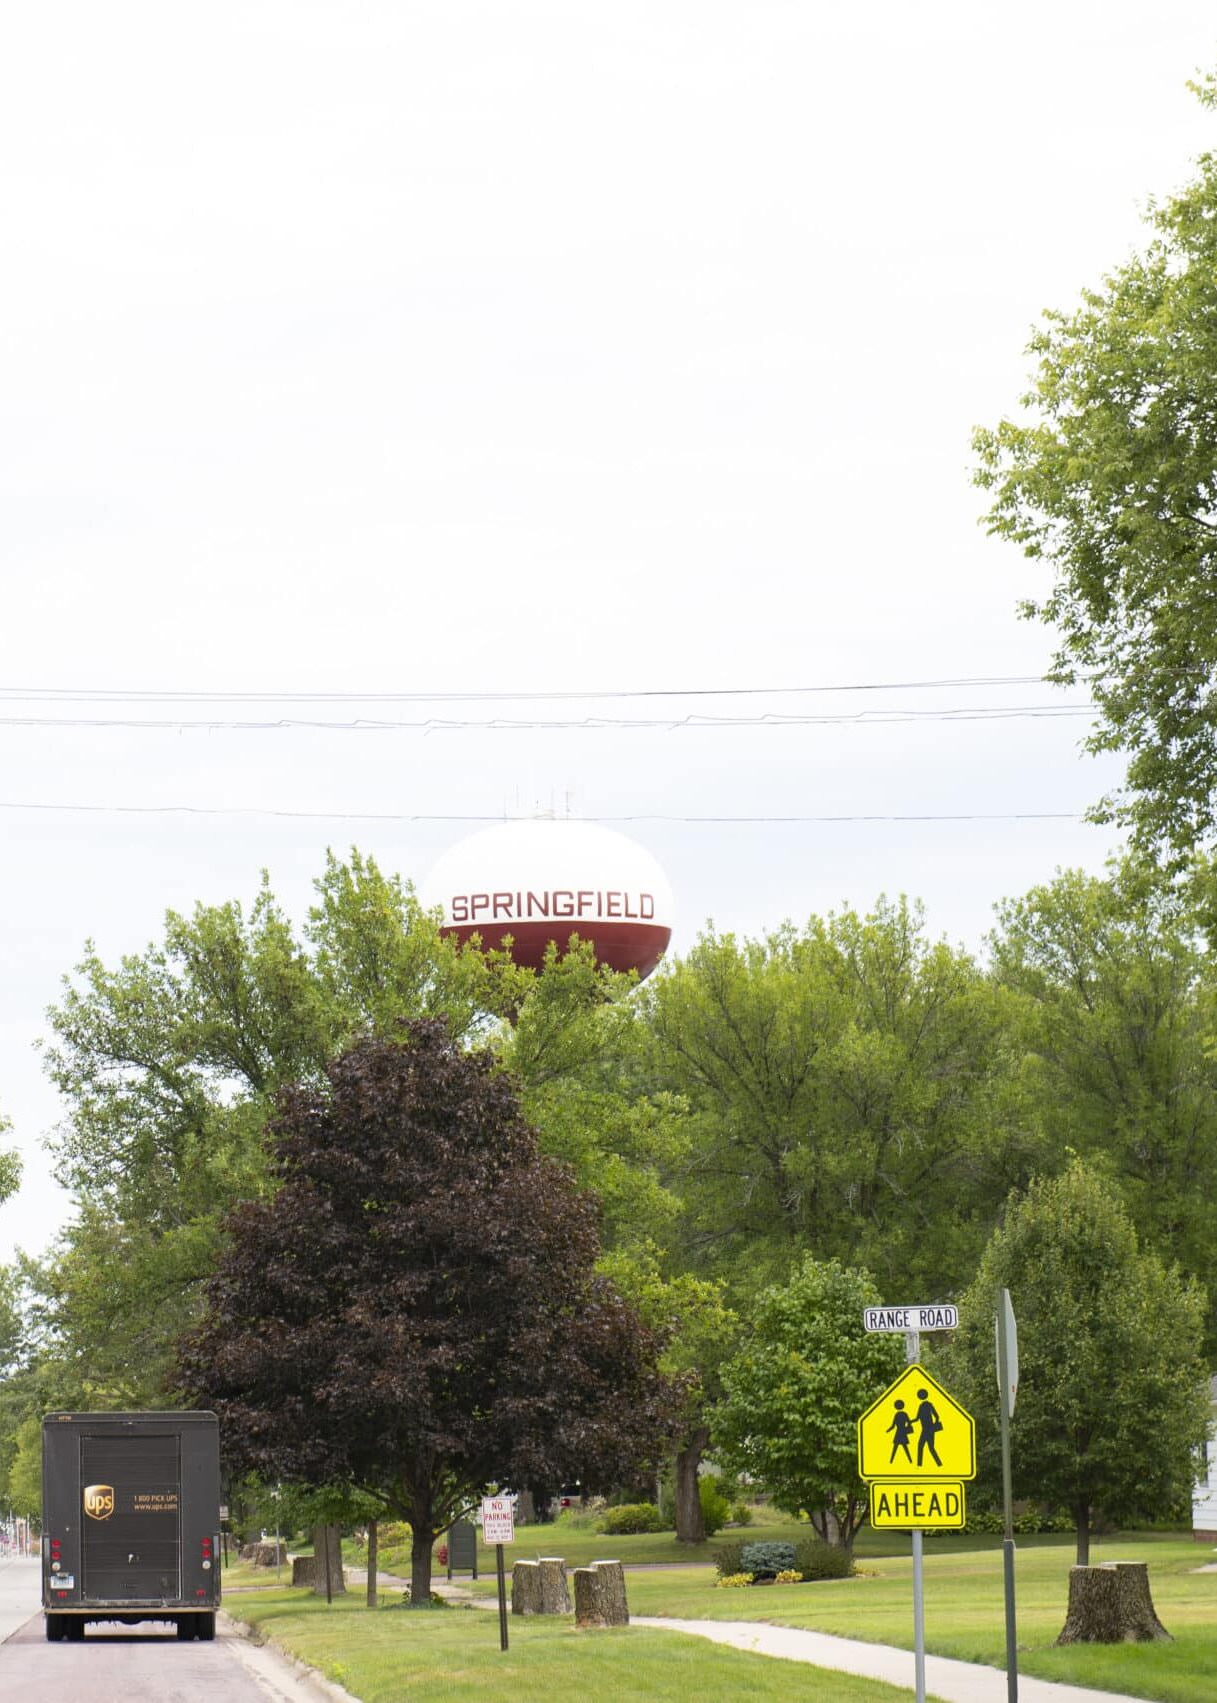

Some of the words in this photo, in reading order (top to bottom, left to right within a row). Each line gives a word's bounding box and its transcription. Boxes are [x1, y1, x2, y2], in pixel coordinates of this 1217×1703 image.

[452, 891, 654, 921] SPRINGFIELD
[869, 1310, 911, 1328] RANGE
[919, 1309, 952, 1326] ROAD
[87, 1495, 112, 1514] ups
[166, 1494, 178, 1502] UPS
[491, 1502, 503, 1510] NO
[877, 1492, 959, 1517] AHEAD
[485, 1512, 511, 1520] PARKING
